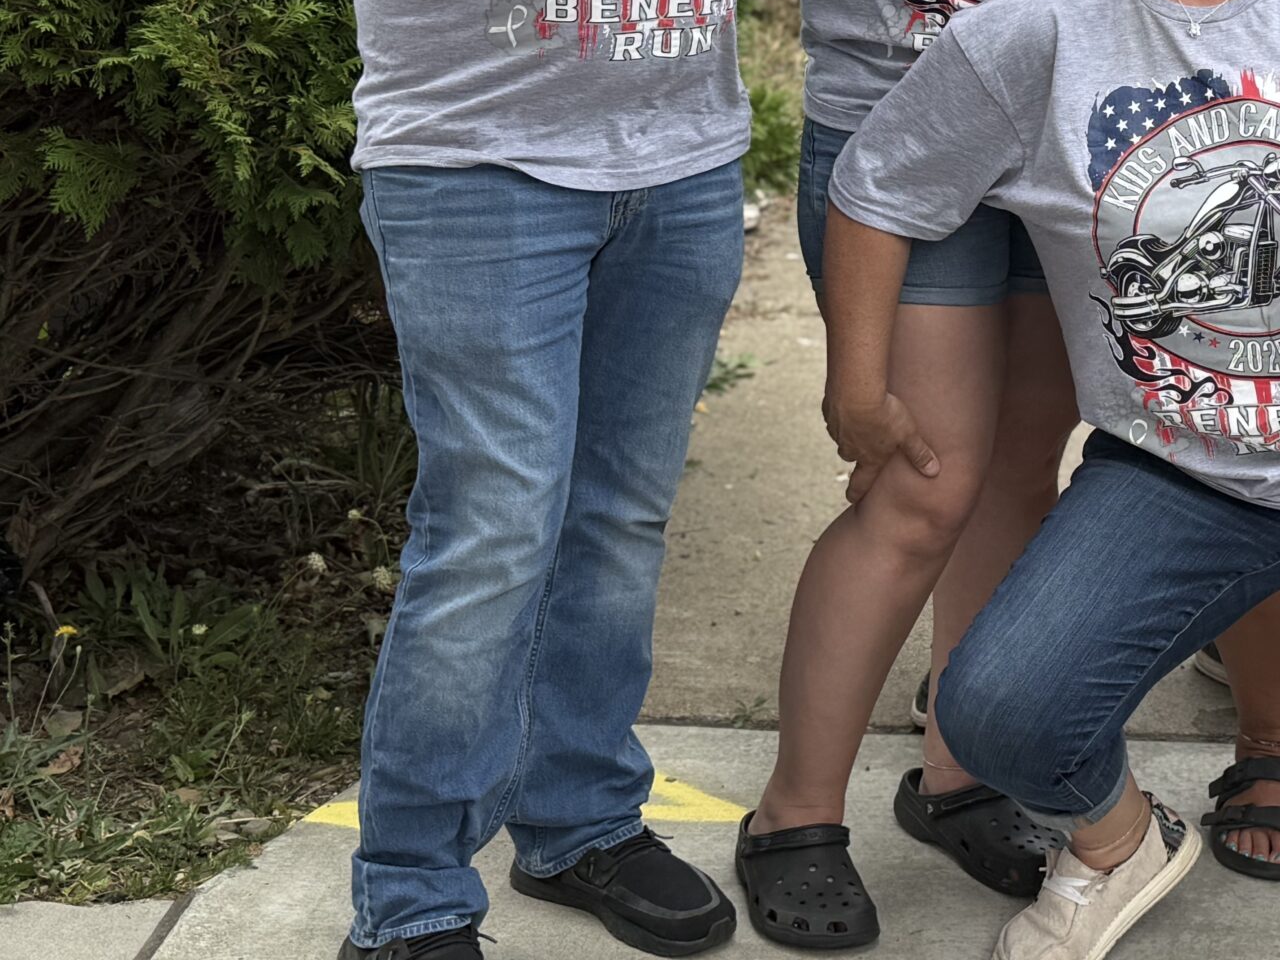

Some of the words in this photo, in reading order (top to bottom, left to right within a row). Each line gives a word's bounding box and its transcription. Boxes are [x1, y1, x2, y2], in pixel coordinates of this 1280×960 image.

[610, 24, 717, 62] RUN
[1102, 147, 1167, 211] KIDS
[1166, 107, 1230, 158] AND
